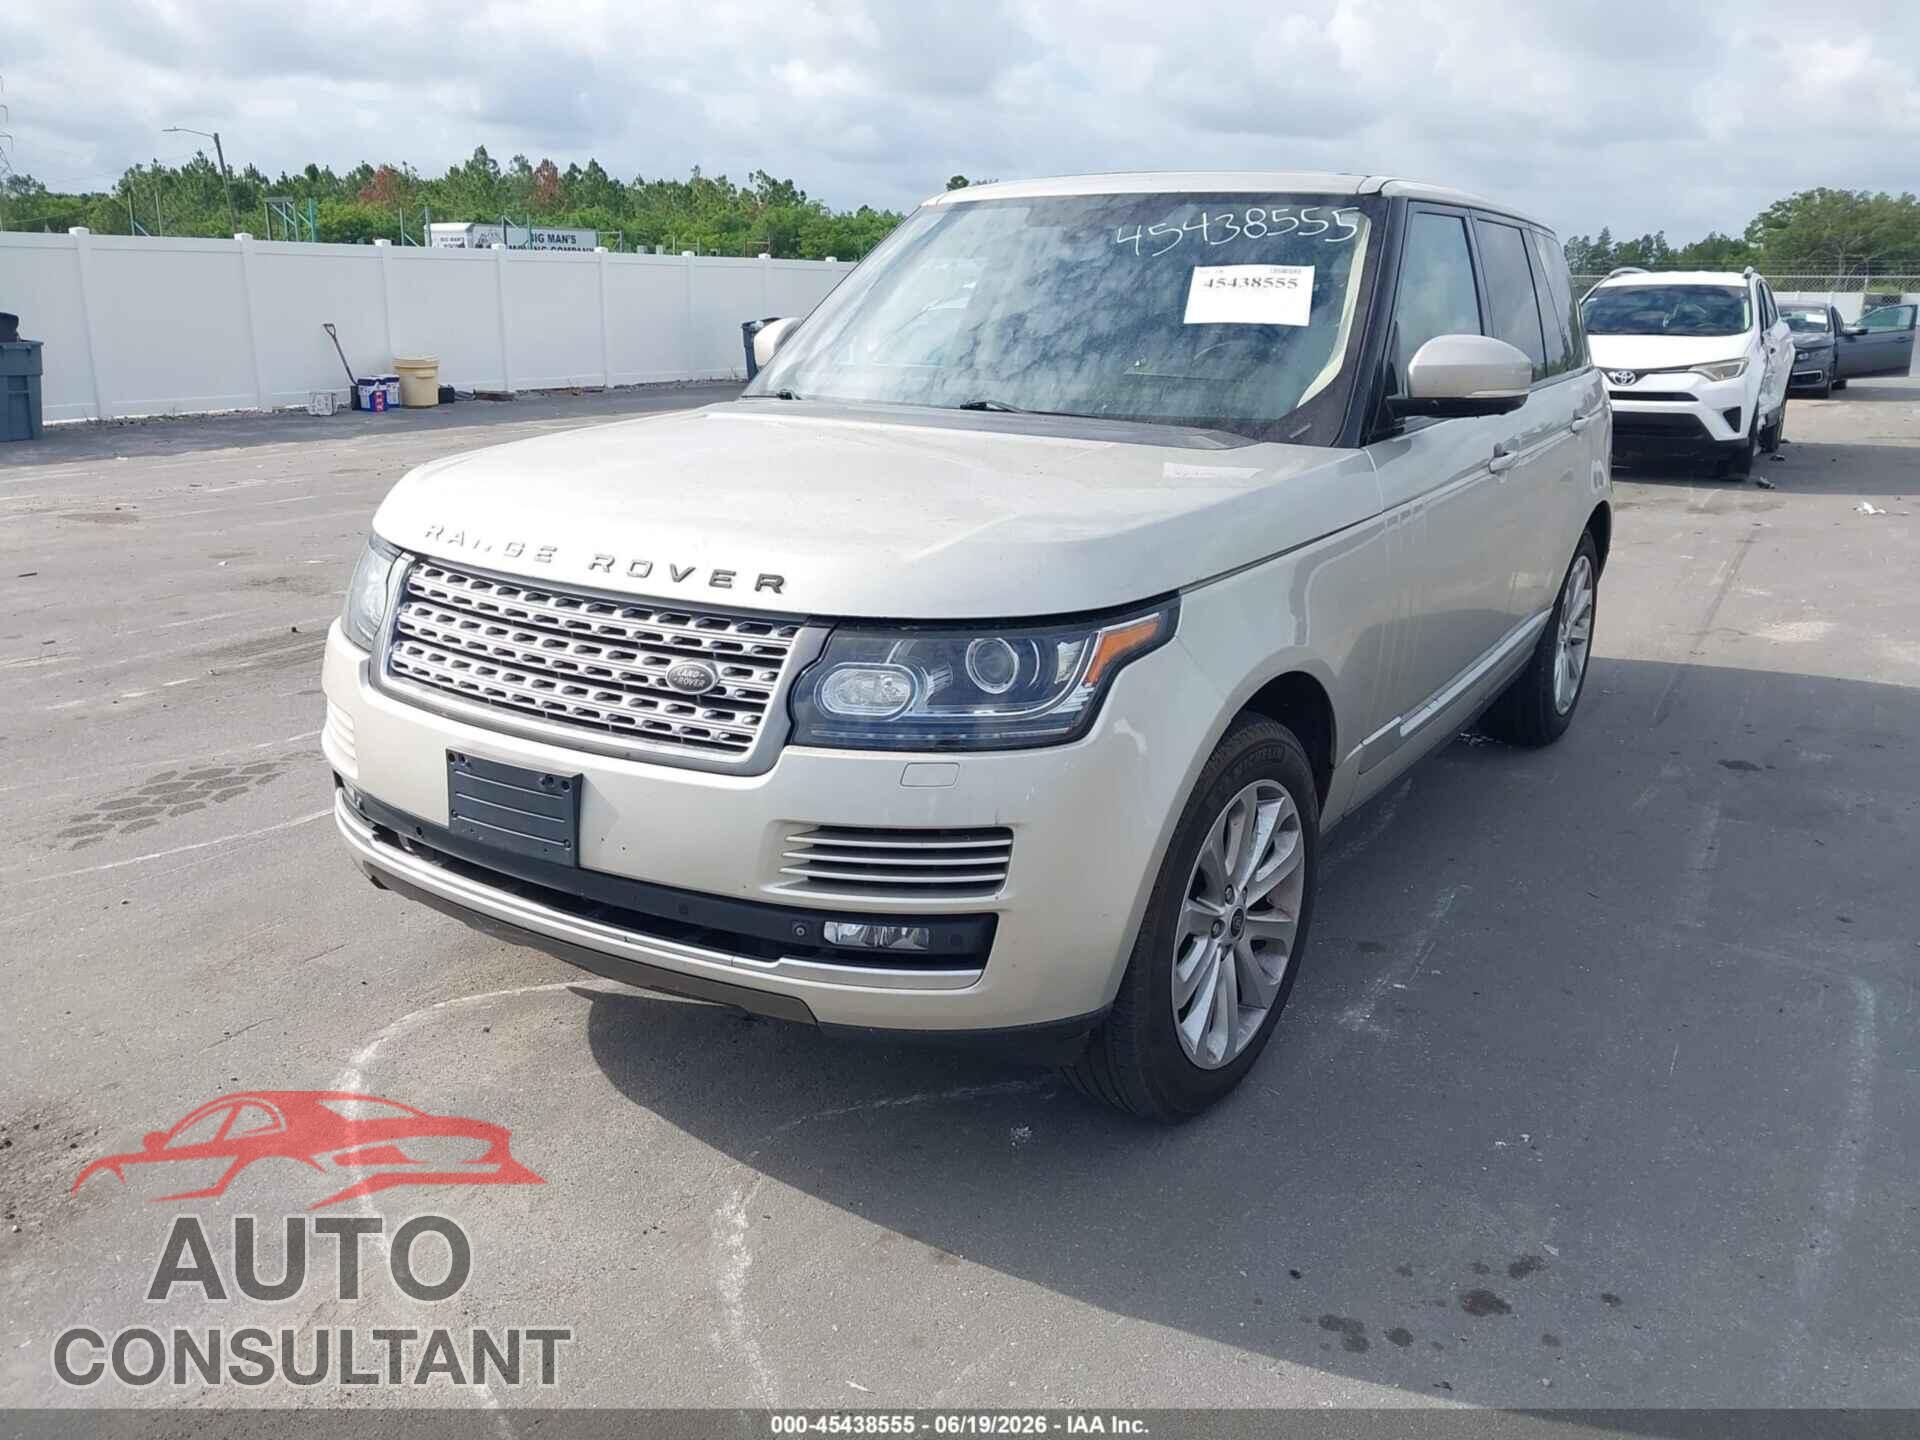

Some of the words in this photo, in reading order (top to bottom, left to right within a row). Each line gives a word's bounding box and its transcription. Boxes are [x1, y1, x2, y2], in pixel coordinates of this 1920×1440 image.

[1116, 207, 1360, 257] 45438555
[1202, 276, 1299, 289] 45438555
[588, 553, 786, 594] ROVER
